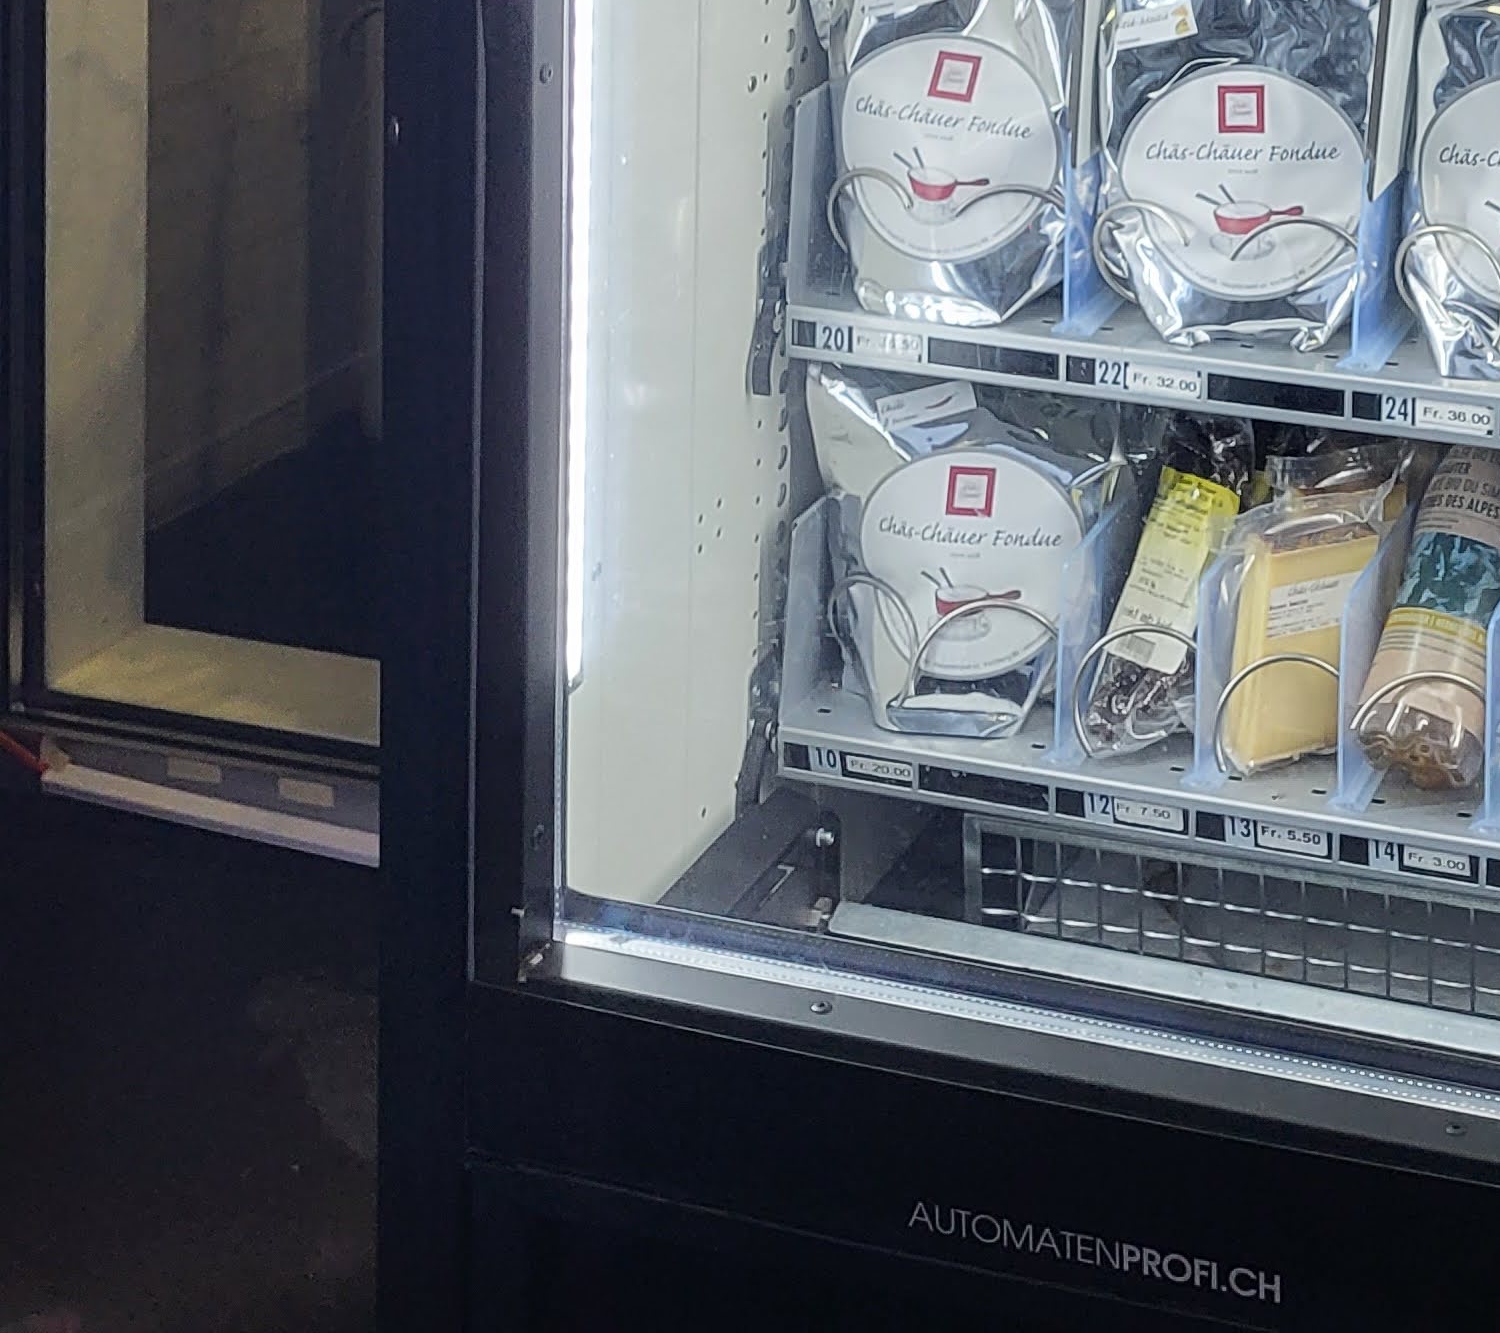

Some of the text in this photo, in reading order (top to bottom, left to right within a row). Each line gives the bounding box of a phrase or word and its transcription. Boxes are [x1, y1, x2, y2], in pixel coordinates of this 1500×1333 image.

[968, 116, 1034, 139] Fondue
[1146, 142, 1340, 161] Chäs-Chäuer Fondue
[1099, 362, 1120, 384] 22
[1385, 397, 1408, 421] 24
[1468, 498, 1500, 518] ALPES
[880, 517, 1063, 547] Chäs-Chäuer Fondue
[1087, 794, 1110, 815] 12
[1373, 841, 1395, 862] 14
[909, 1201, 1281, 1303] AUTOMATENPROFI.CH
